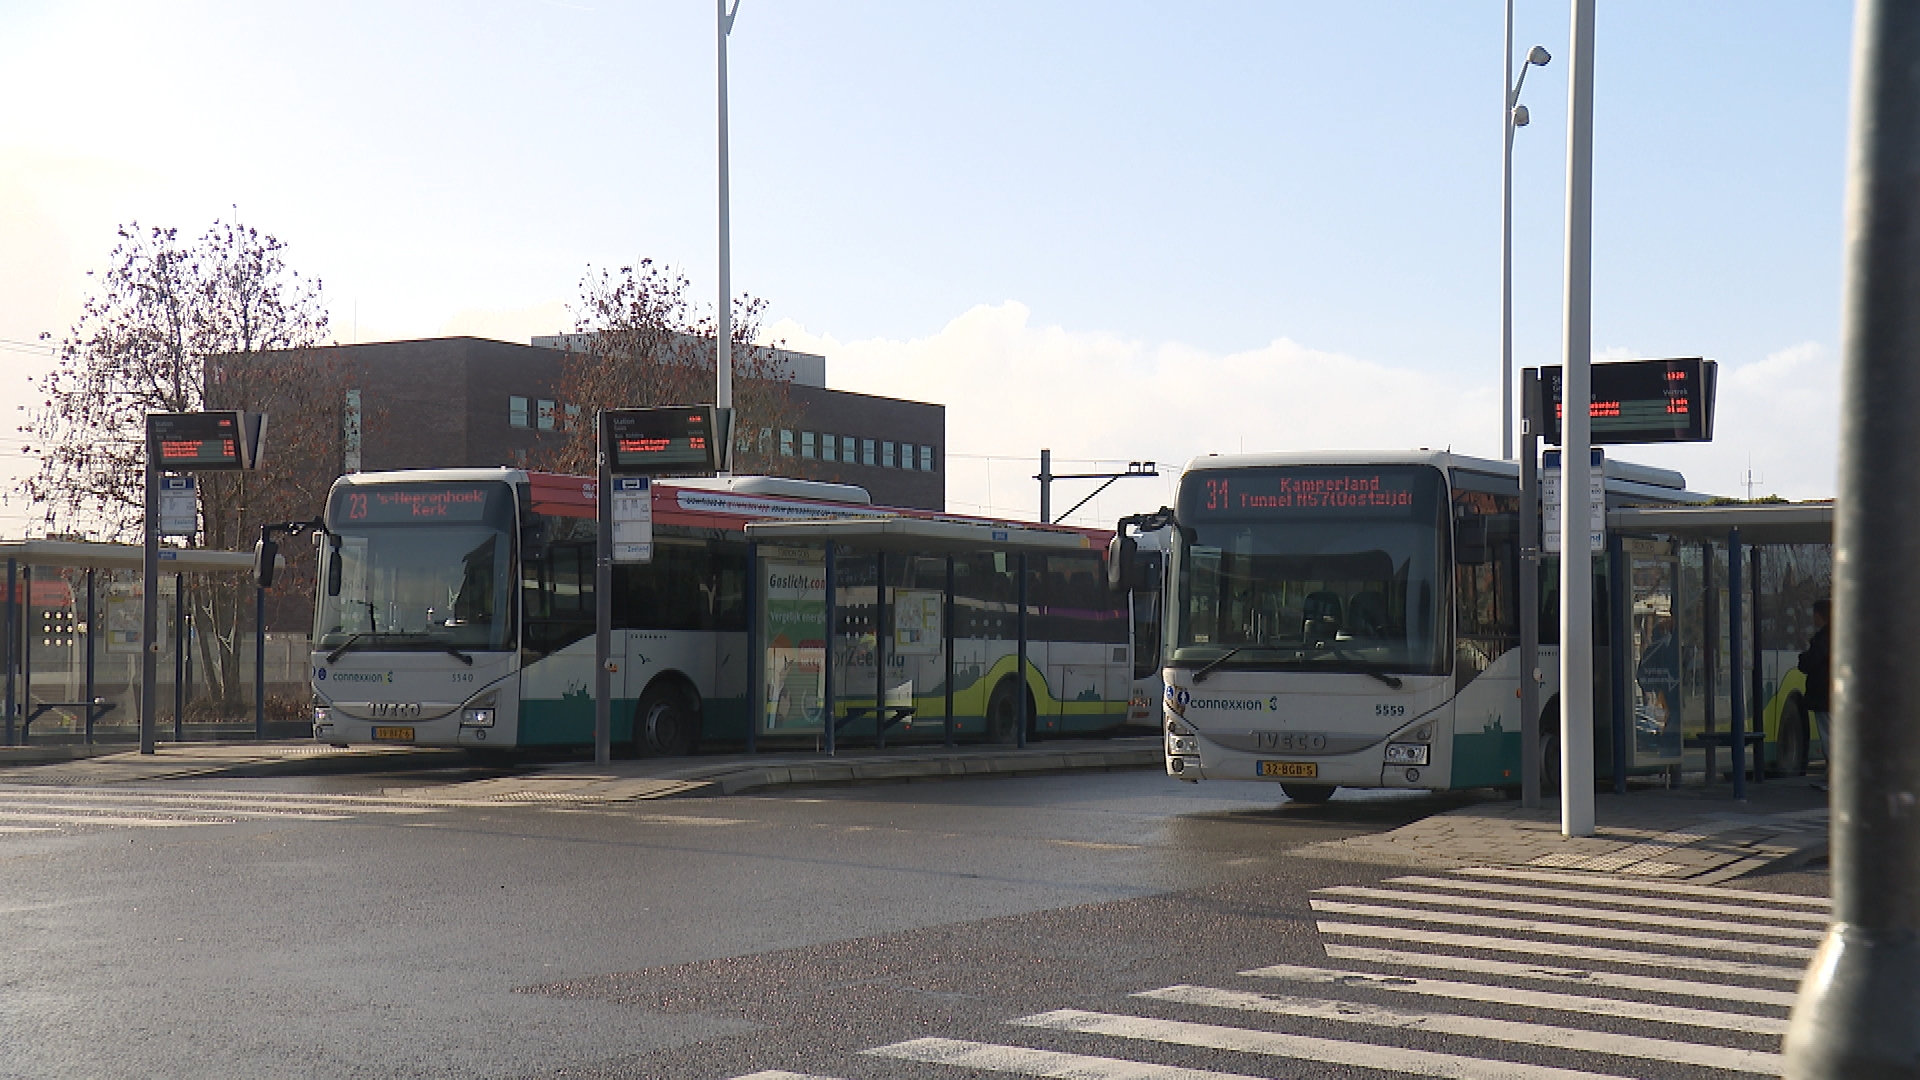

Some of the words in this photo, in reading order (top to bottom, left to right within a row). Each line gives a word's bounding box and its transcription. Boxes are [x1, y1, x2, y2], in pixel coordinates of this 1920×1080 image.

[1206, 478, 1229, 510] 31
[1280, 476, 1380, 493] Kamperland
[1239, 491, 1292, 507] Tunnel
[349, 493, 368, 519] 23
[412, 503, 447, 516] Kerk
[332, 671, 383, 682] connexxion
[369, 703, 421, 717] IVECO
[1190, 697, 1262, 711] connexxion
[1375, 704, 1405, 717] 5559
[1255, 732, 1327, 750] IVECO
[1265, 763, 1313, 775] 32-BGB-5
